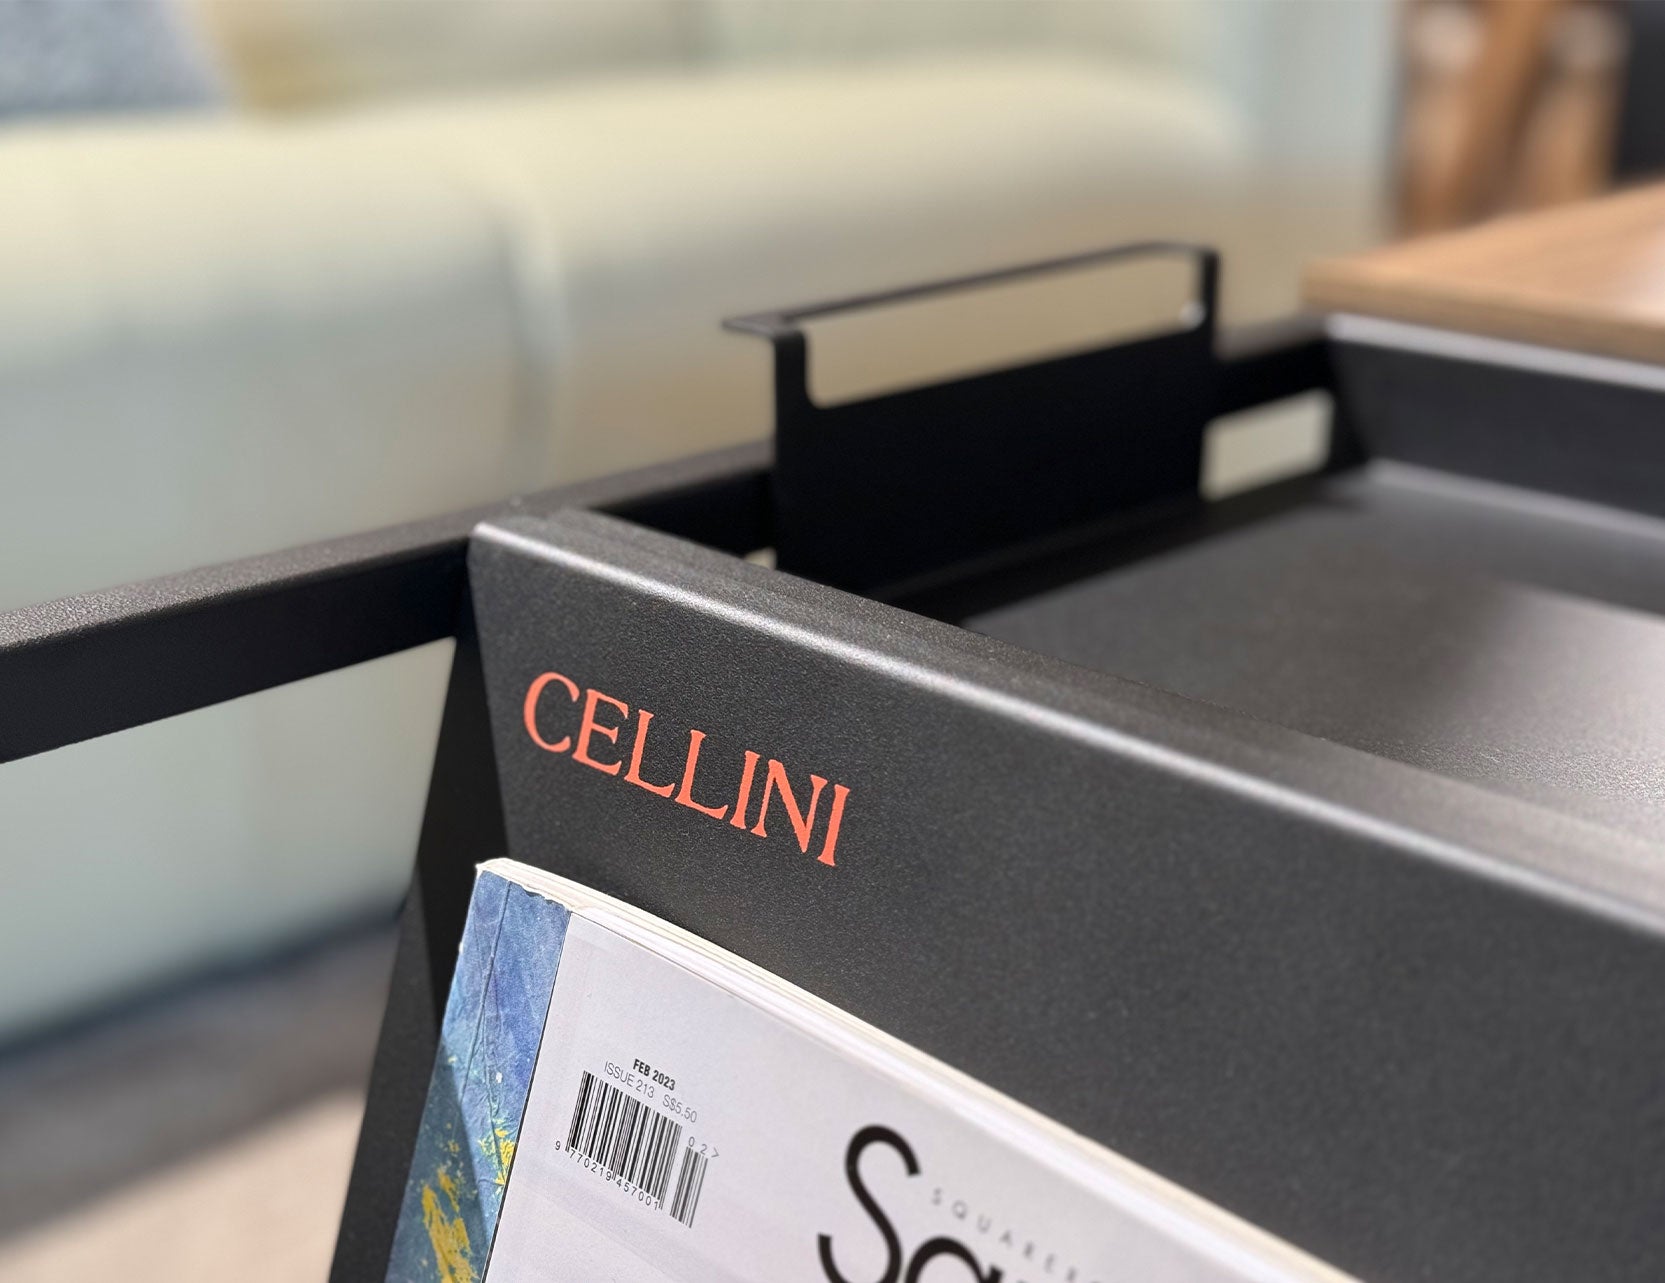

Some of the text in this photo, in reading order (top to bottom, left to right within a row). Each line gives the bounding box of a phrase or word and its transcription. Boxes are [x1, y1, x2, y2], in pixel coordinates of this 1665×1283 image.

[523, 671, 850, 867] CELLINI
[603, 1060, 698, 1123] ISSUE 213 S$5.50
[632, 1058, 676, 1092] FEB 2023
[930, 1186, 1104, 1283] SQUARER
